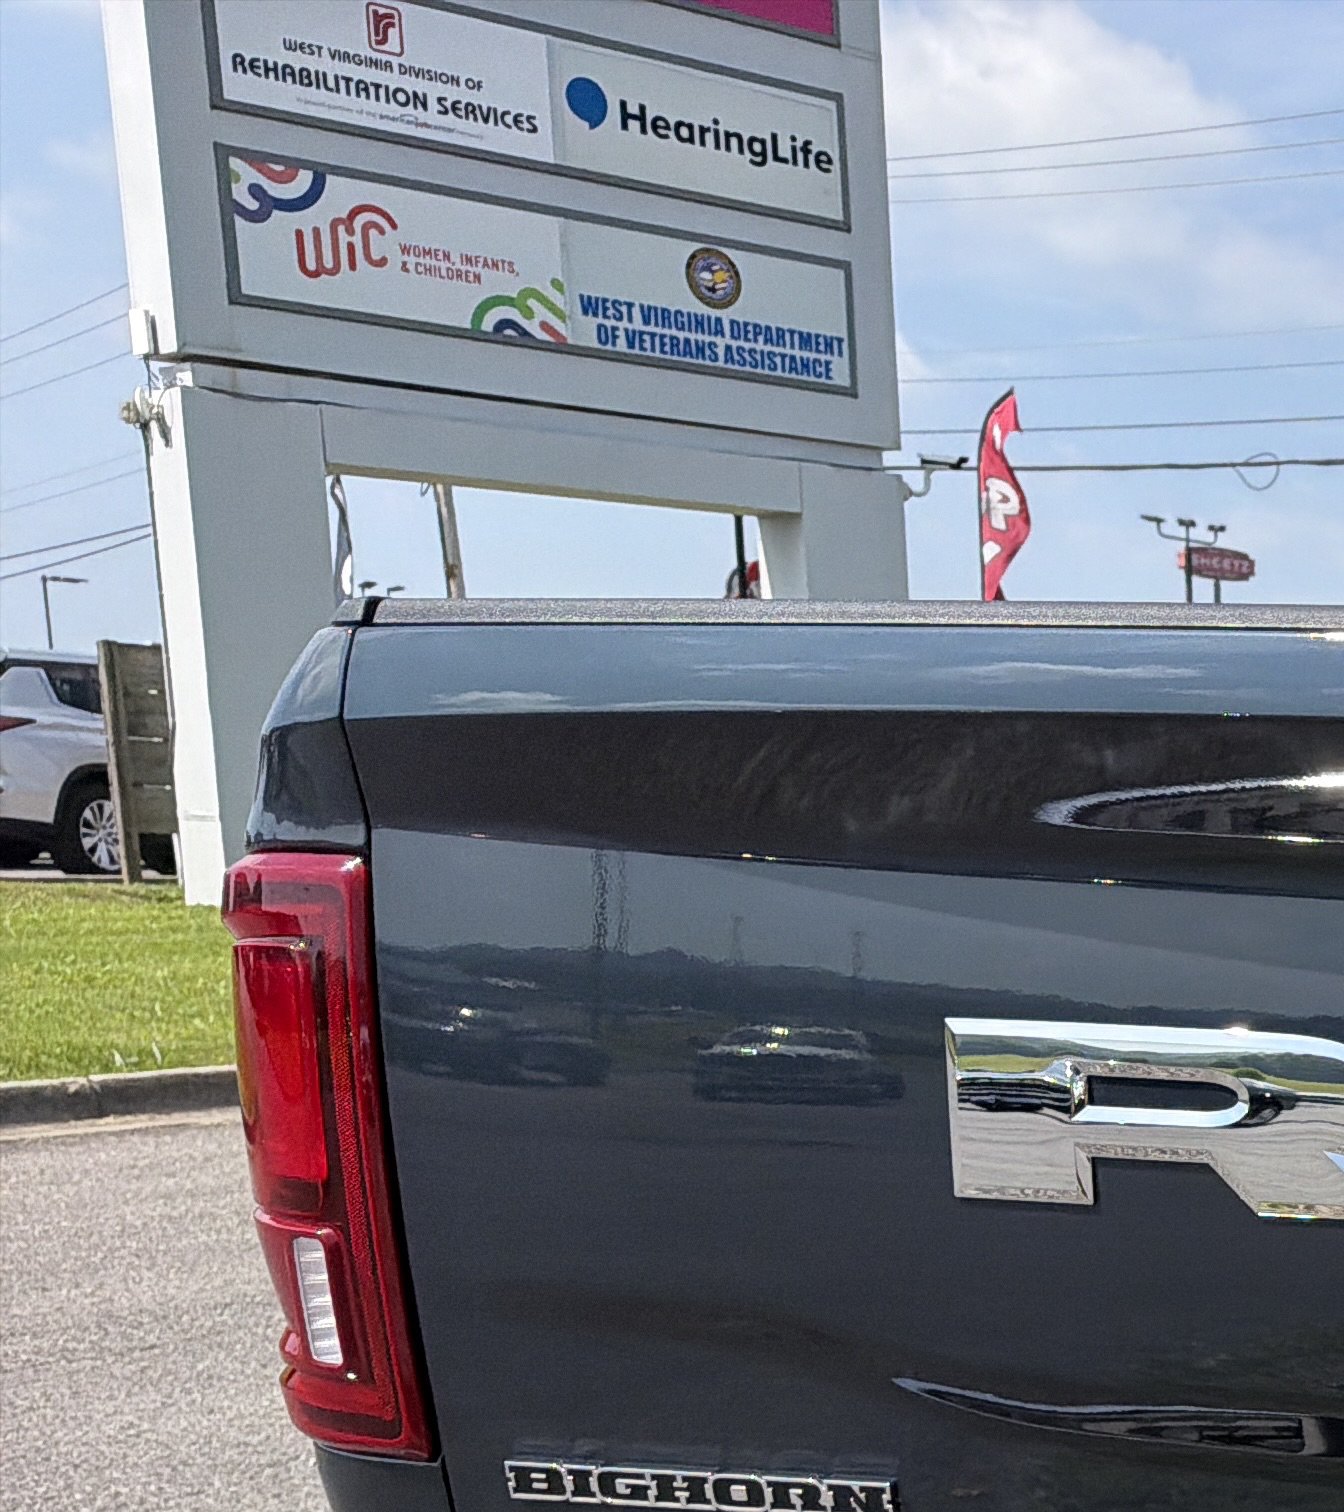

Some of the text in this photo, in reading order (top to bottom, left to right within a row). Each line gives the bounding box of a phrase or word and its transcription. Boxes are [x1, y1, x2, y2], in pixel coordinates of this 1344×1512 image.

[231, 52, 429, 112] REHABILITATION
[436, 96, 539, 134] SERVICES
[282, 37, 484, 92] WEST VIRGINIA DIVISION OF
[618, 98, 835, 174] HearingLife
[398, 242, 521, 278] WOMEN, INFANTS,
[400, 260, 482, 286] & CHILDREN
[578, 293, 845, 359] WEST VIRGINIA DEPARTMENT
[595, 323, 835, 381] OF VETERANS ASSISTANCE
